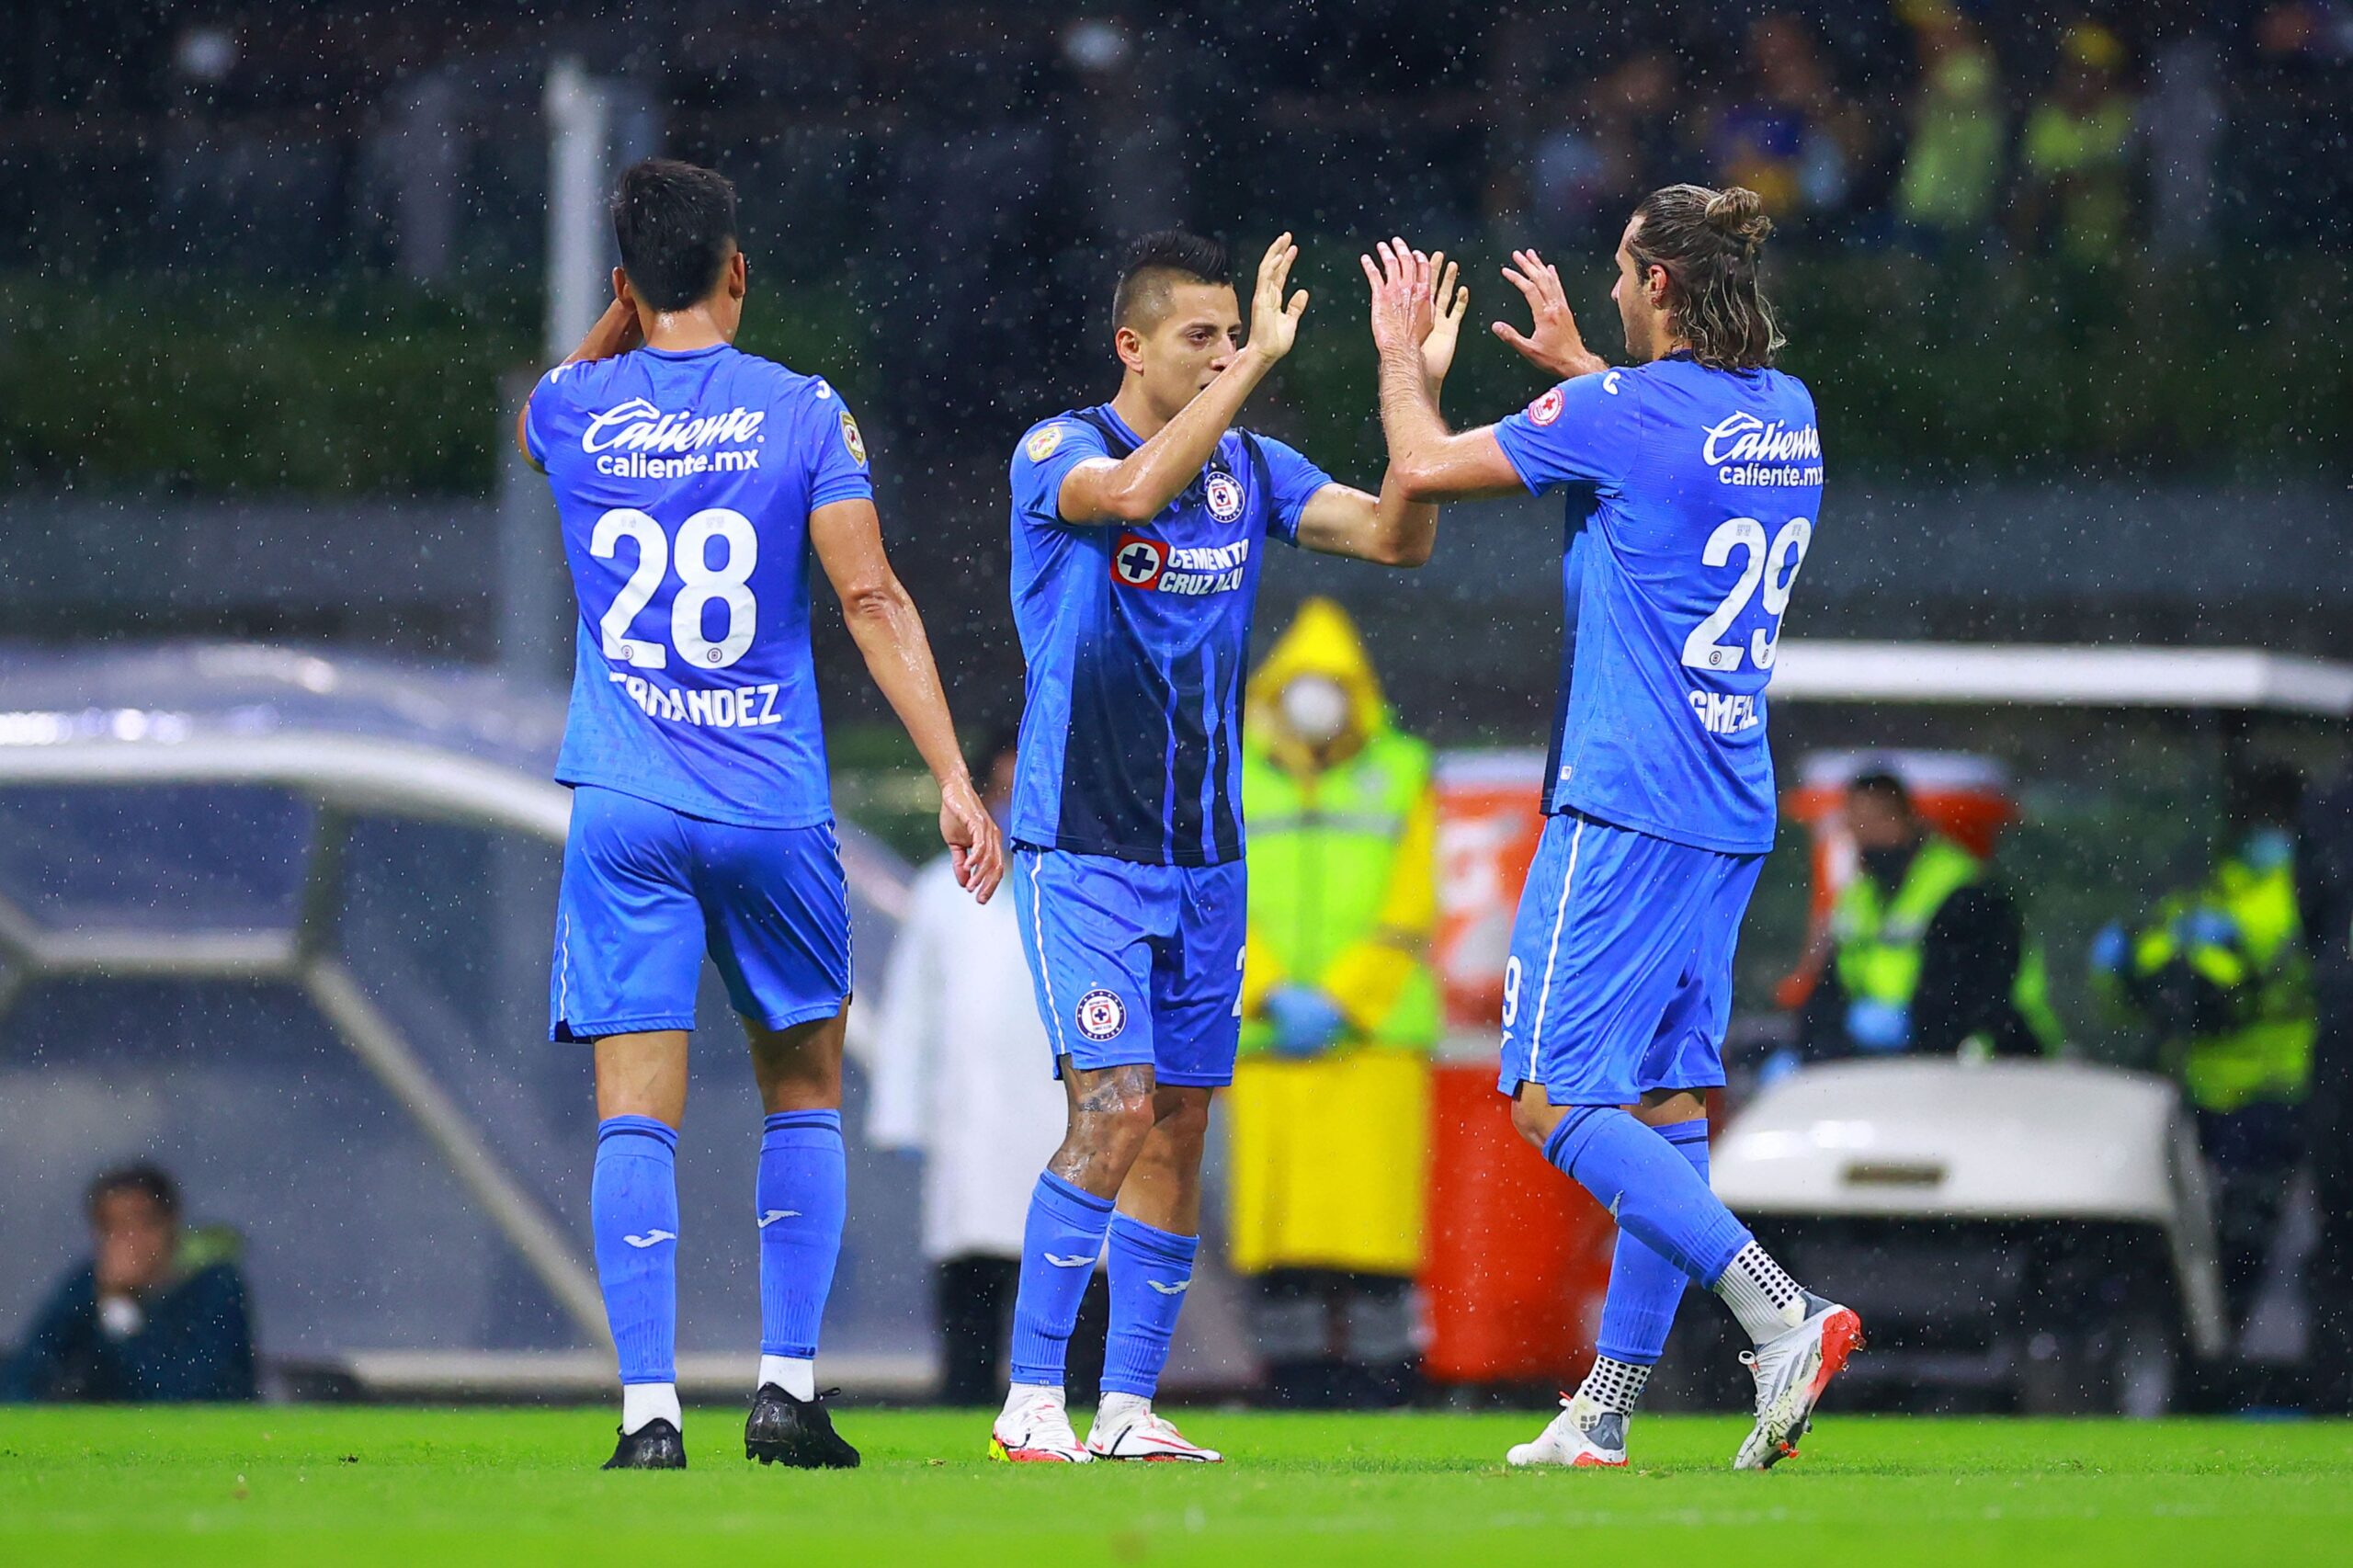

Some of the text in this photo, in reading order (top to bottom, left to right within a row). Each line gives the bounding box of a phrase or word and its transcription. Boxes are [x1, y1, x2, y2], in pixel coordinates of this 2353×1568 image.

[582, 396, 765, 454] Caliente
[1700, 410, 1820, 466] Caliente
[596, 449, 759, 479] caliente.mx
[1158, 566, 1244, 596] CRUZ AZU
[1166, 538, 1249, 571] CEMENTO
[589, 507, 758, 670] 28
[1681, 517, 1812, 672] 29
[1502, 955, 1521, 1028] 9
